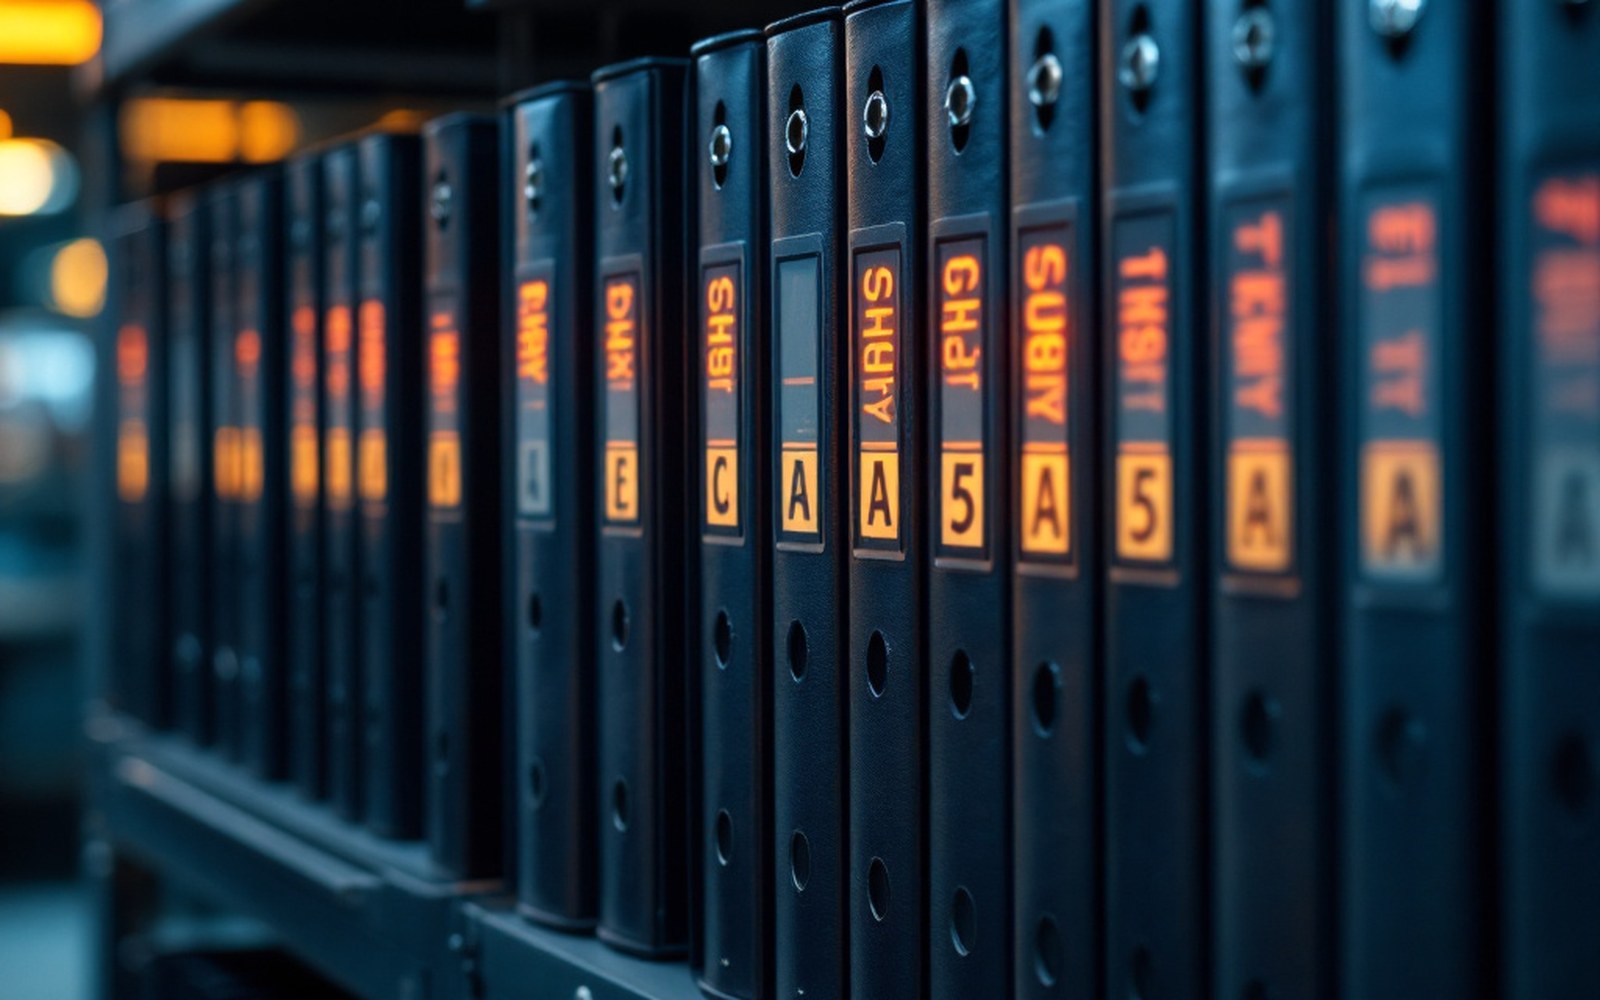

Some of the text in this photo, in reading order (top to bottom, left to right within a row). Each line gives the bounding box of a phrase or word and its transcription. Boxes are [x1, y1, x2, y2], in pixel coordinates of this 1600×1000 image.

[616, 457, 628, 510] E
[713, 456, 730, 515] C
[788, 459, 810, 521] A
[867, 461, 892, 527] A
[951, 463, 975, 534] 5
[1031, 466, 1061, 539] A
[1130, 467, 1158, 544] 5
[1242, 470, 1277, 549] A
[1383, 467, 1430, 560] A
